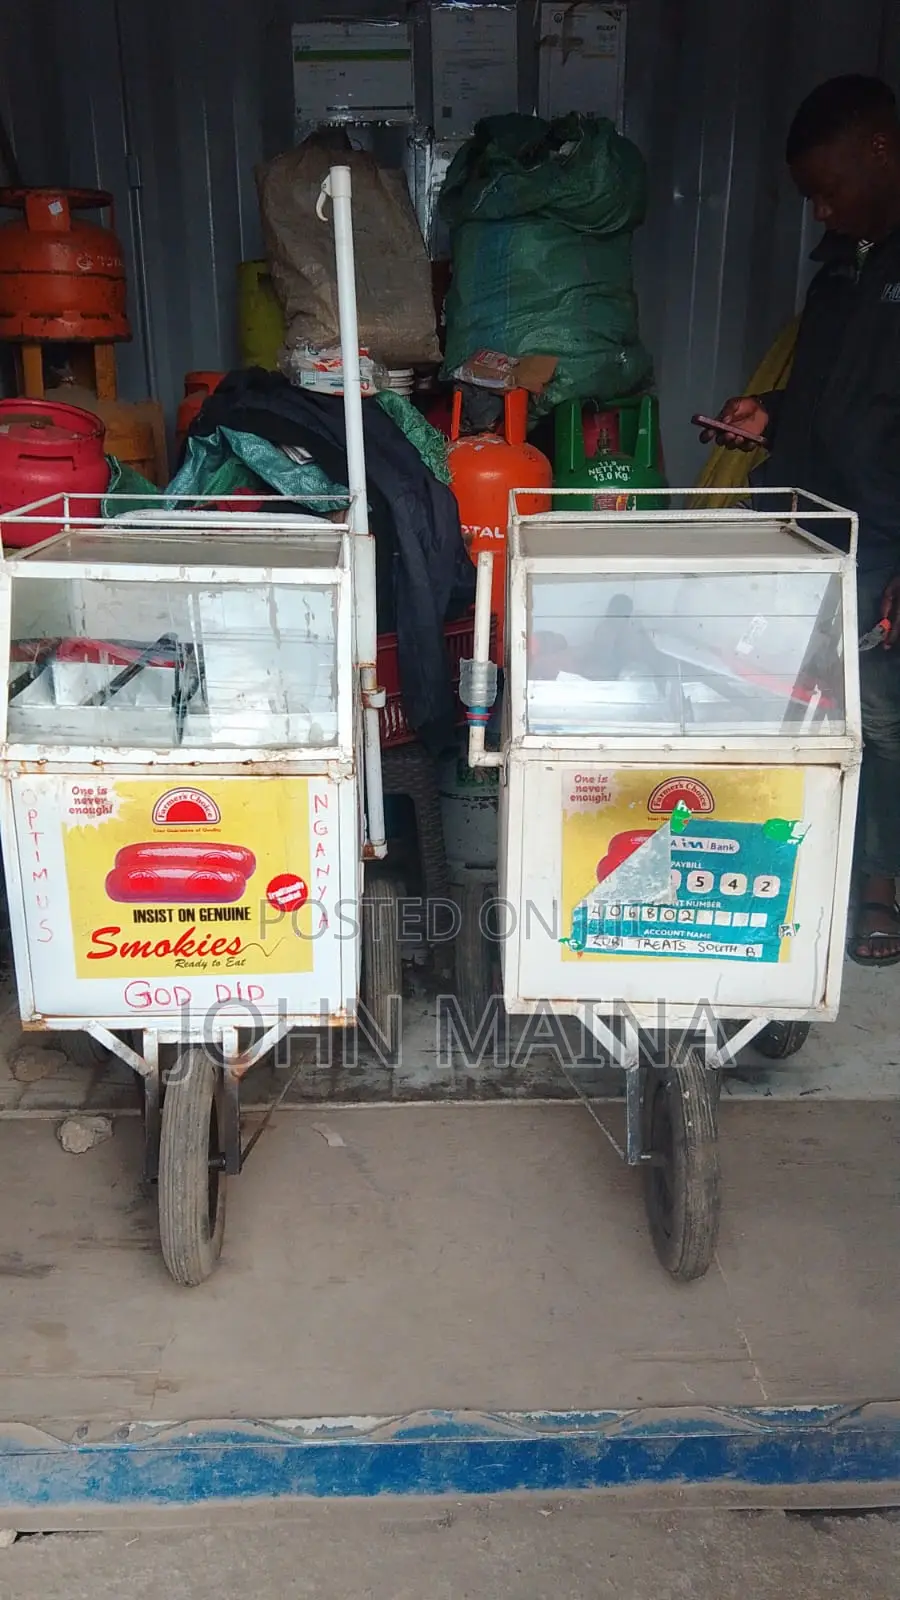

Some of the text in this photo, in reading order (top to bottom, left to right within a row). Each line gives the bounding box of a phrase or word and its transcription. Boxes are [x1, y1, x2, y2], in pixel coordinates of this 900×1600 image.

[588, 465, 613, 476] NETT
[593, 471, 613, 481] 13.0
[574, 774, 609, 783] One is
[71, 786, 94, 795] One
[575, 785, 607, 793] never
[653, 782, 684, 807] Farmer's
[685, 782, 707, 807] Choice
[73, 797, 108, 805] never
[569, 792, 612, 804] enough!
[68, 804, 113, 817] enough!
[157, 792, 213, 819] Farmer's Choice
[711, 842, 735, 852] Bank
[133, 907, 251, 923] INSIST ON GENUINE
[686, 931, 712, 939] NAME
[86, 926, 241, 959] Smokies
[637, 939, 686, 951] TREATS
[699, 942, 738, 953] SOUTH
[174, 957, 246, 969] Ready to Eat
[124, 980, 265, 1008] GOD DID
